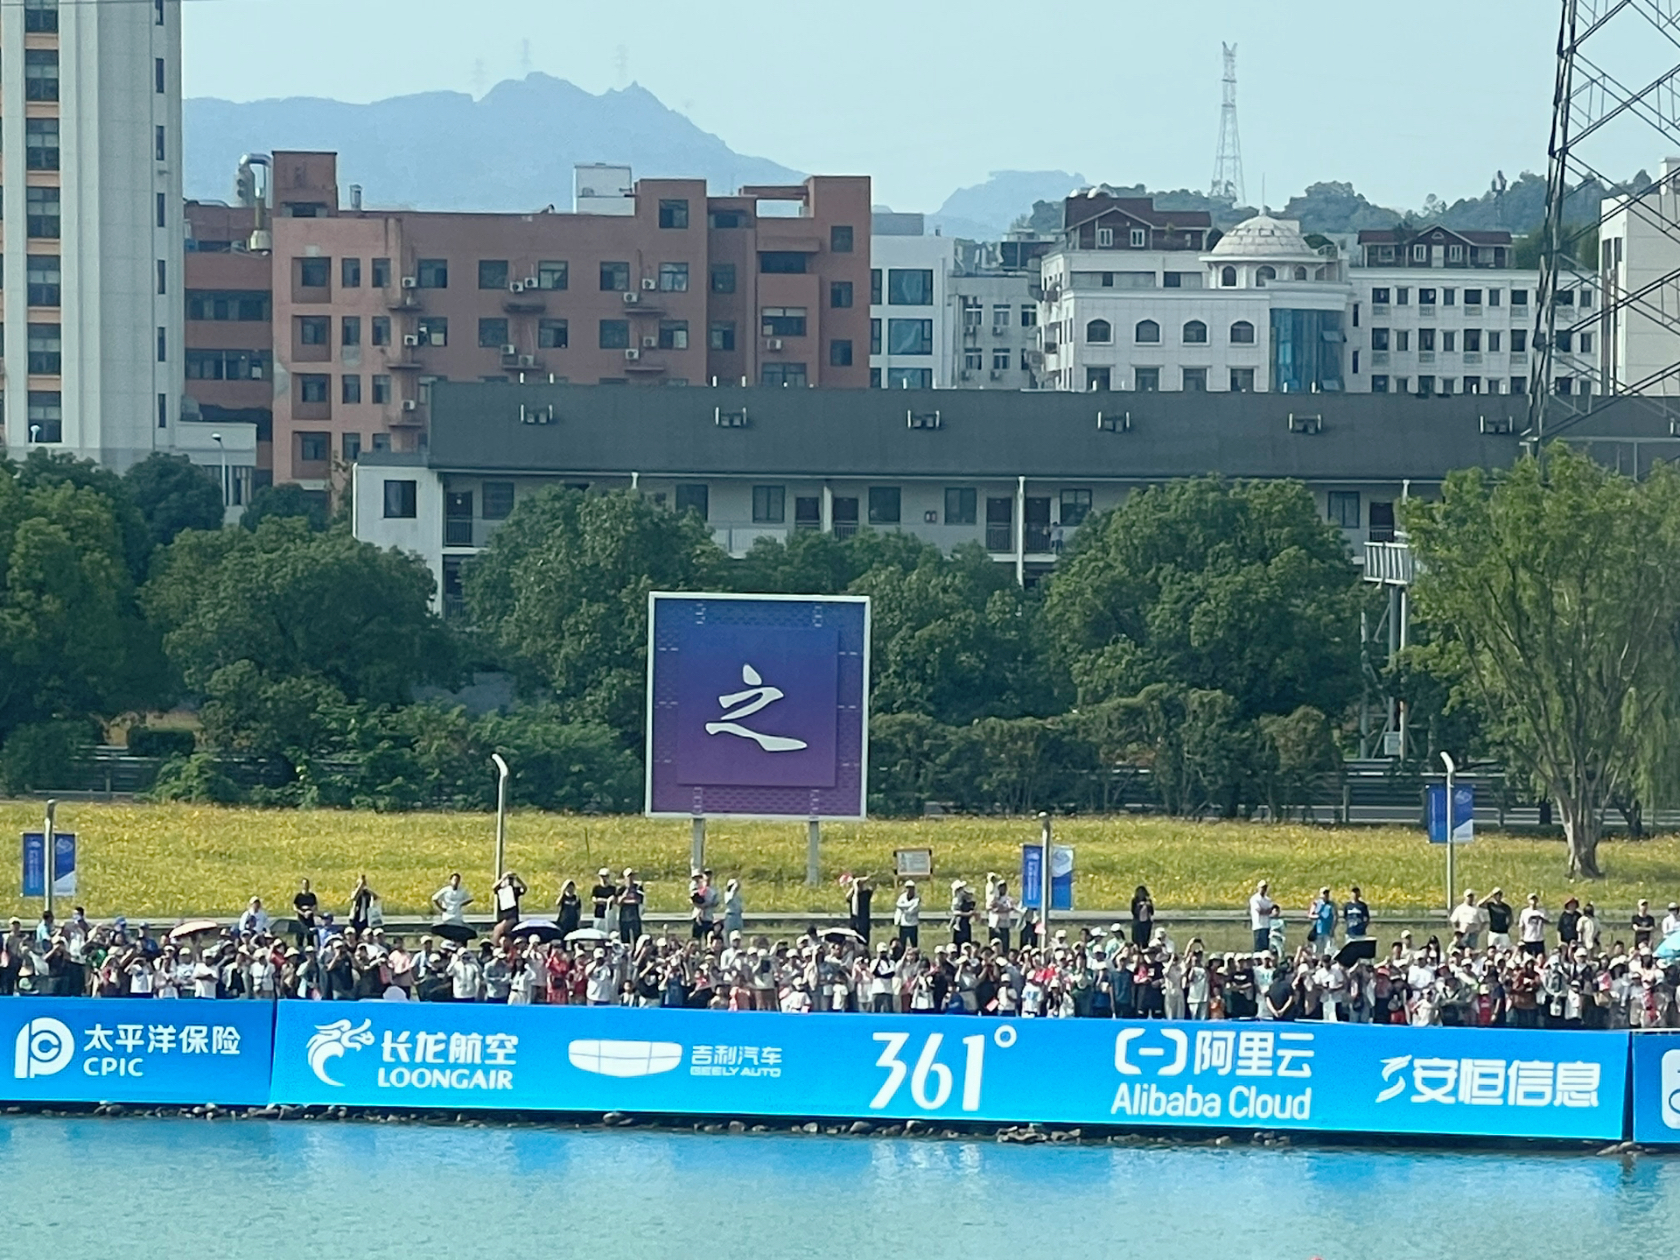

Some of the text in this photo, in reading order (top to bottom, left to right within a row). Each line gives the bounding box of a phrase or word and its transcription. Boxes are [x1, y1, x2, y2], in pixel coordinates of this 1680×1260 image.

[705, 664, 808, 752] 之
[83, 1023, 241, 1056] 太平洋保险
[381, 1030, 519, 1066] 长龙航空
[691, 1045, 783, 1066] 吉利汽车
[1193, 1030, 1316, 1078] 阿里云
[83, 1056, 144, 1078] CPIC
[377, 1067, 513, 1091] LOONGAIR
[690, 1065, 782, 1078] GEELY AUTO
[1412, 1056, 1602, 1109] 安恒信息
[1110, 1082, 1313, 1121] Alibaba Cloud
